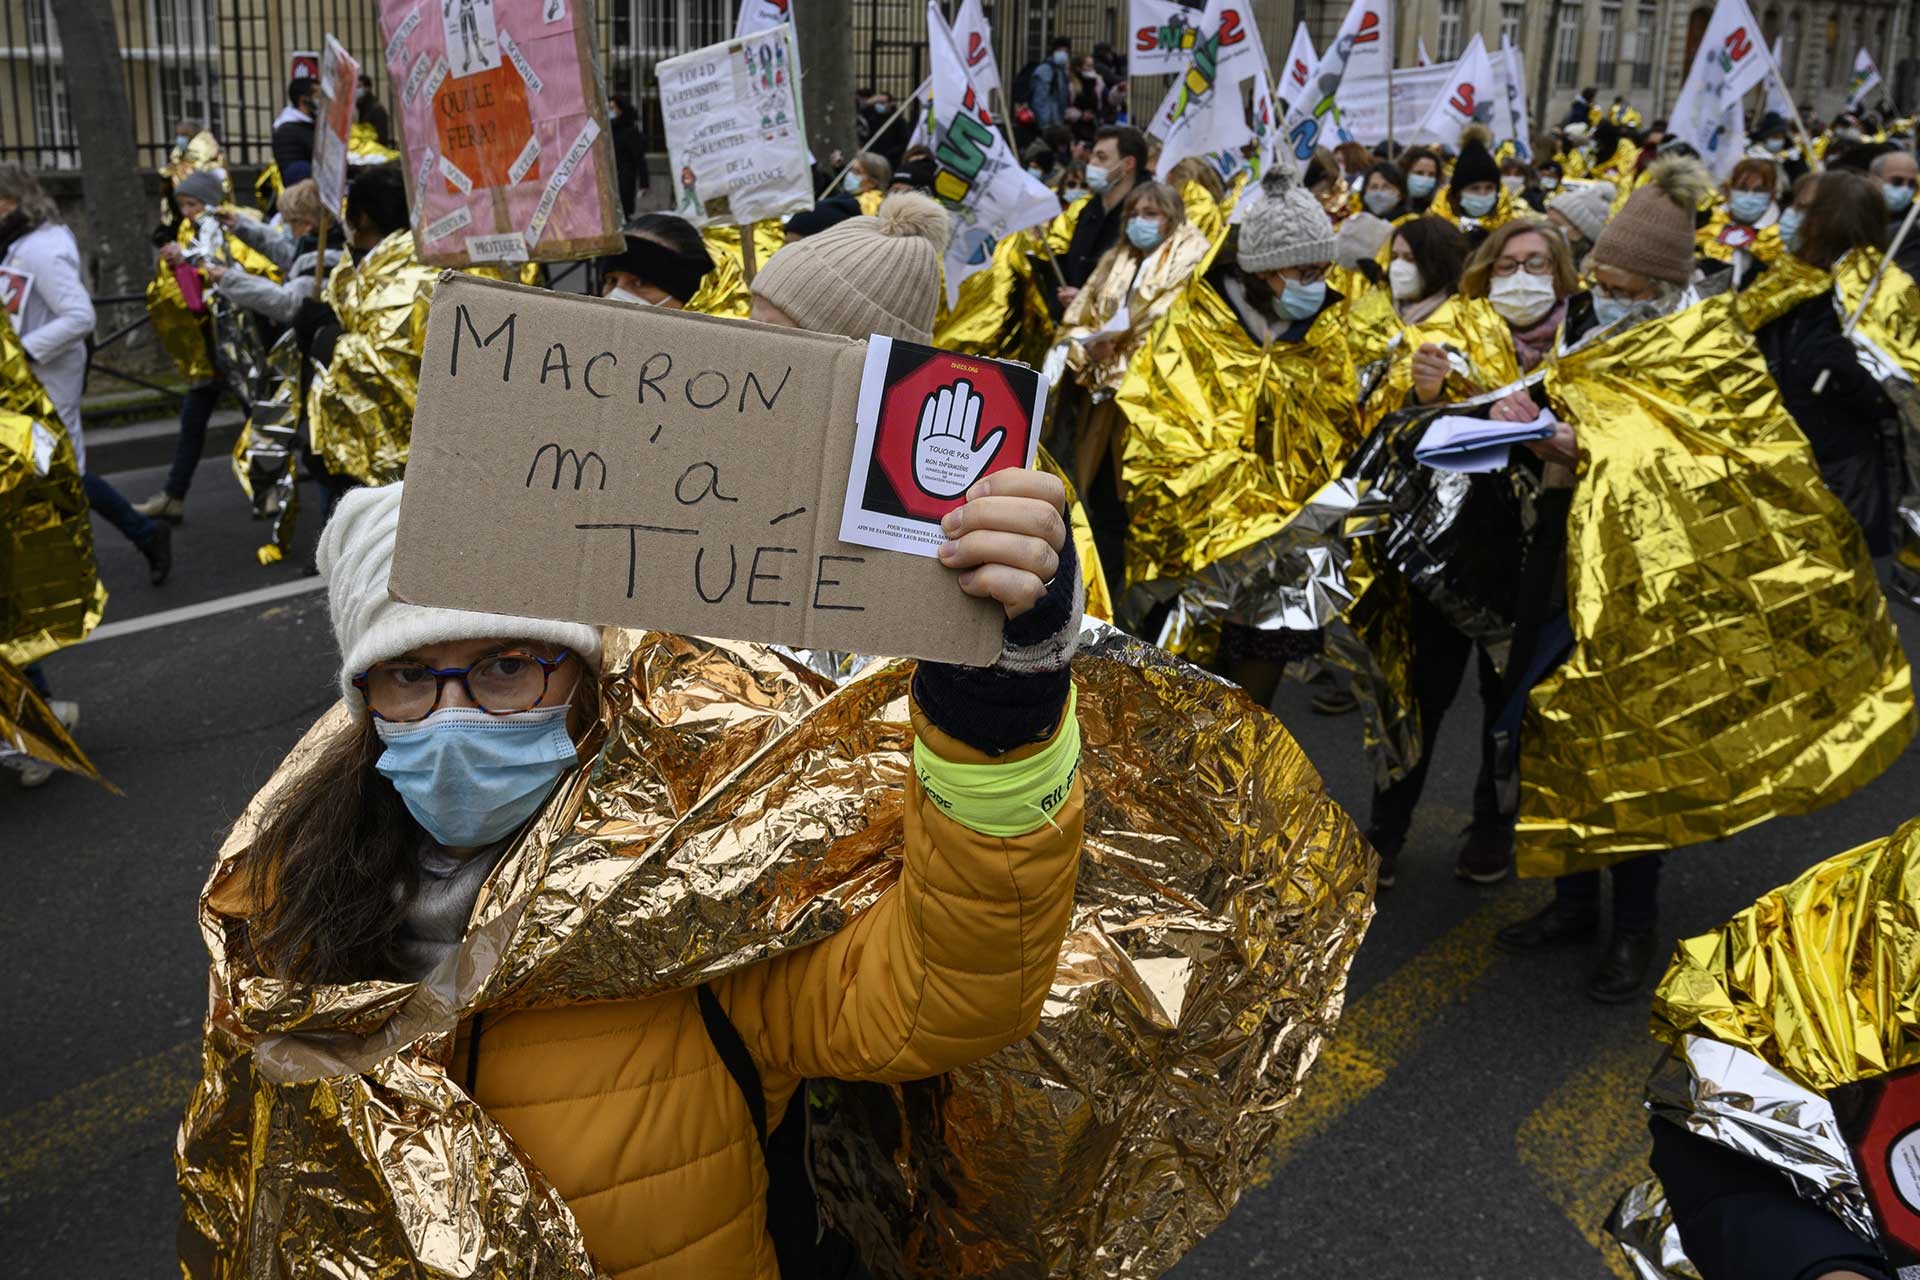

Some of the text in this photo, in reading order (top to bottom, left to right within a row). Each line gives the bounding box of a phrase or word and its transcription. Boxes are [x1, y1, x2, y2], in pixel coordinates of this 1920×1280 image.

[473, 83, 495, 109] LE
[449, 304, 791, 412] MACRON
[925, 458, 938, 466] MON
[929, 445, 970, 460] TOUCHE PAS
[857, 524, 869, 532] AFIN
[875, 528, 902, 538] FAVORISER
[575, 506, 866, 611] TUÉE
